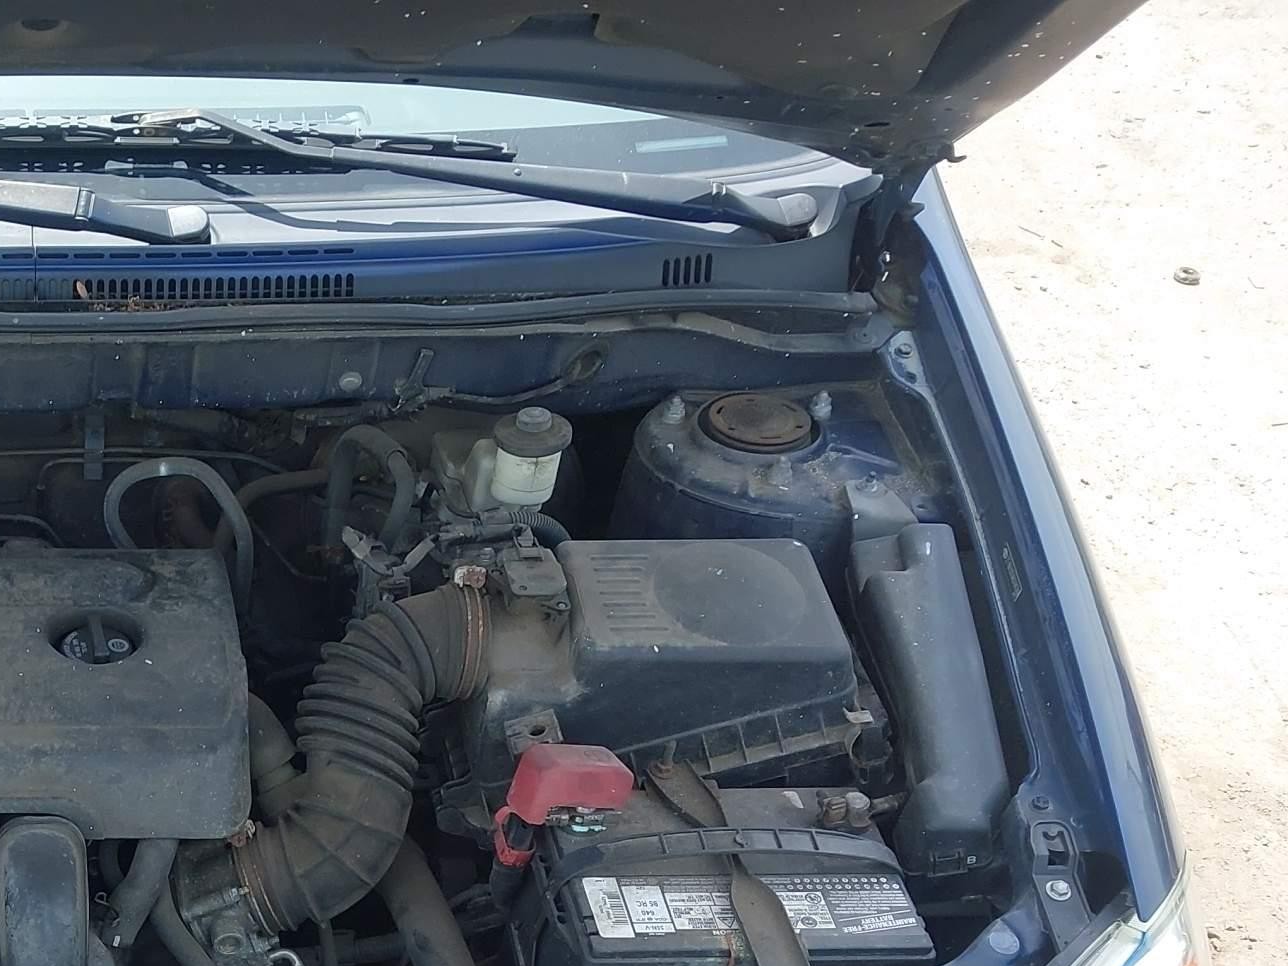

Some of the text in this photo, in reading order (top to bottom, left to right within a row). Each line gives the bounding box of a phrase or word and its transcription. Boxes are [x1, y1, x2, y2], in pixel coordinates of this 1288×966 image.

[967, 855, 977, 865] B
[861, 914, 893, 924] BATTERY
[842, 917, 917, 933] MAINTENANCE-FREE
